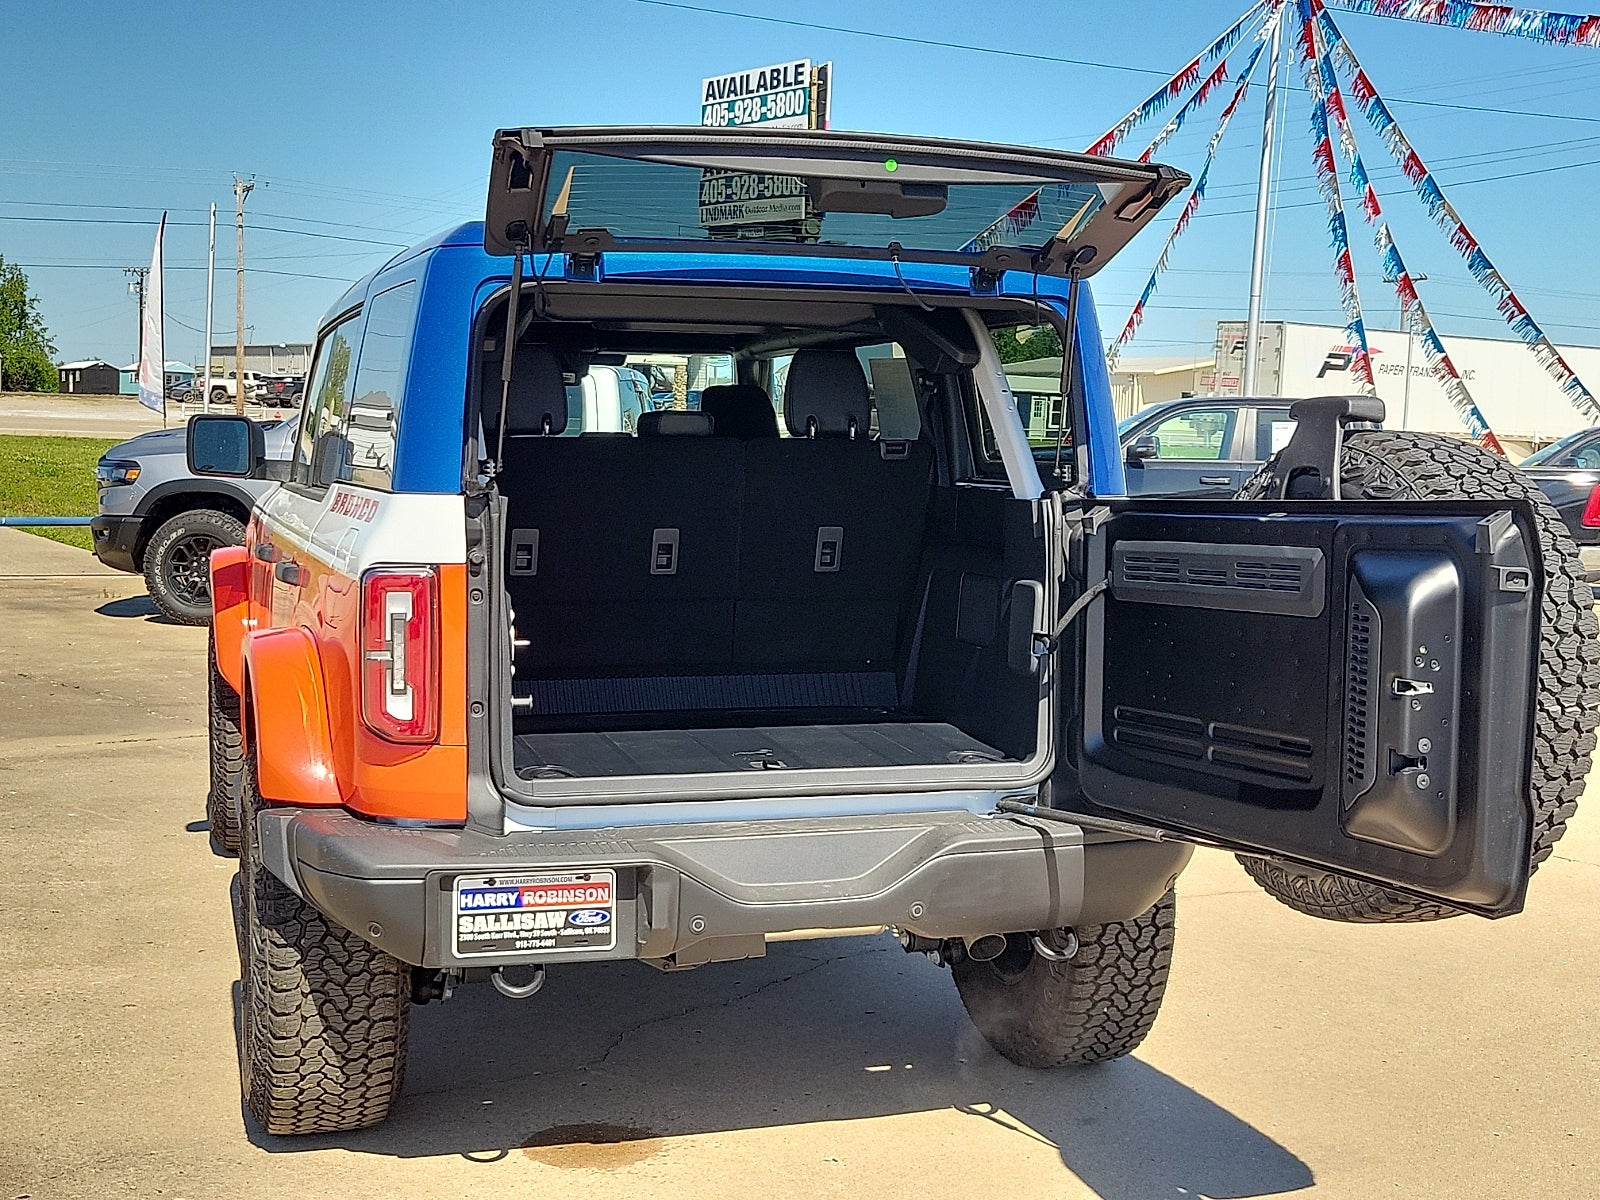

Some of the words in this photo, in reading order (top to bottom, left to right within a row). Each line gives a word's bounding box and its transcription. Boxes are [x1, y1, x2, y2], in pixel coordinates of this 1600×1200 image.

[705, 62, 806, 102] AVAILABLE
[703, 88, 805, 127] 405-928-5800
[701, 174, 801, 204] 405-928-5800
[700, 204, 745, 223] LINDMARK
[1378, 363, 1405, 376] PAPER
[330, 492, 380, 523] BRONCO
[499, 876, 573, 886] WWW.HARRYROBINSON.COM
[461, 891, 519, 908] HARRY
[523, 887, 610, 905] ROBINSON
[459, 910, 568, 933] SALLISAW
[574, 911, 605, 924] Ford
